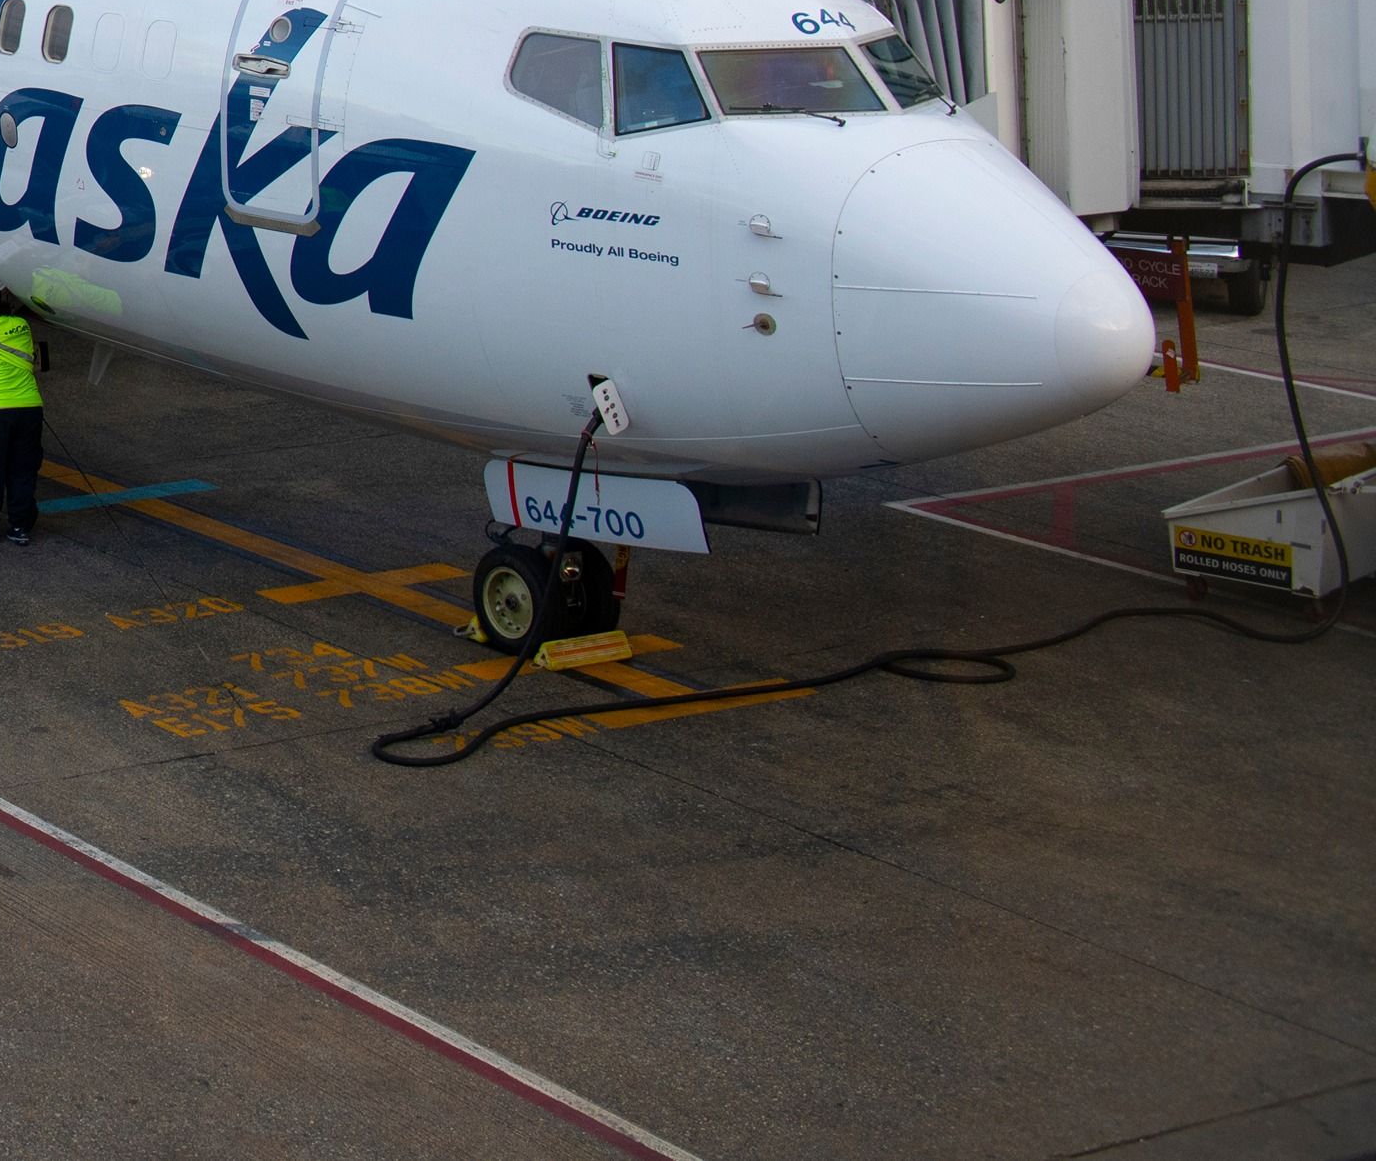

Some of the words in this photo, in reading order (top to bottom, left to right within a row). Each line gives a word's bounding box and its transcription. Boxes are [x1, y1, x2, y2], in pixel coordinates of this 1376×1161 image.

[791, 8, 856, 35] 644
[576, 207, 661, 226] BOEING
[550, 238, 604, 257] Proudly
[607, 245, 624, 258] All
[628, 248, 680, 267] Boeing
[1138, 259, 1182, 276] CYCLE
[1201, 534, 1225, 551] NO
[1230, 540, 1285, 561] TRASH
[1179, 553, 1219, 568] ROLLED
[1222, 561, 1256, 576] HOSES
[1259, 567, 1287, 580] ONLY
[105, 597, 244, 630] A320
[152, 700, 301, 738] E175
